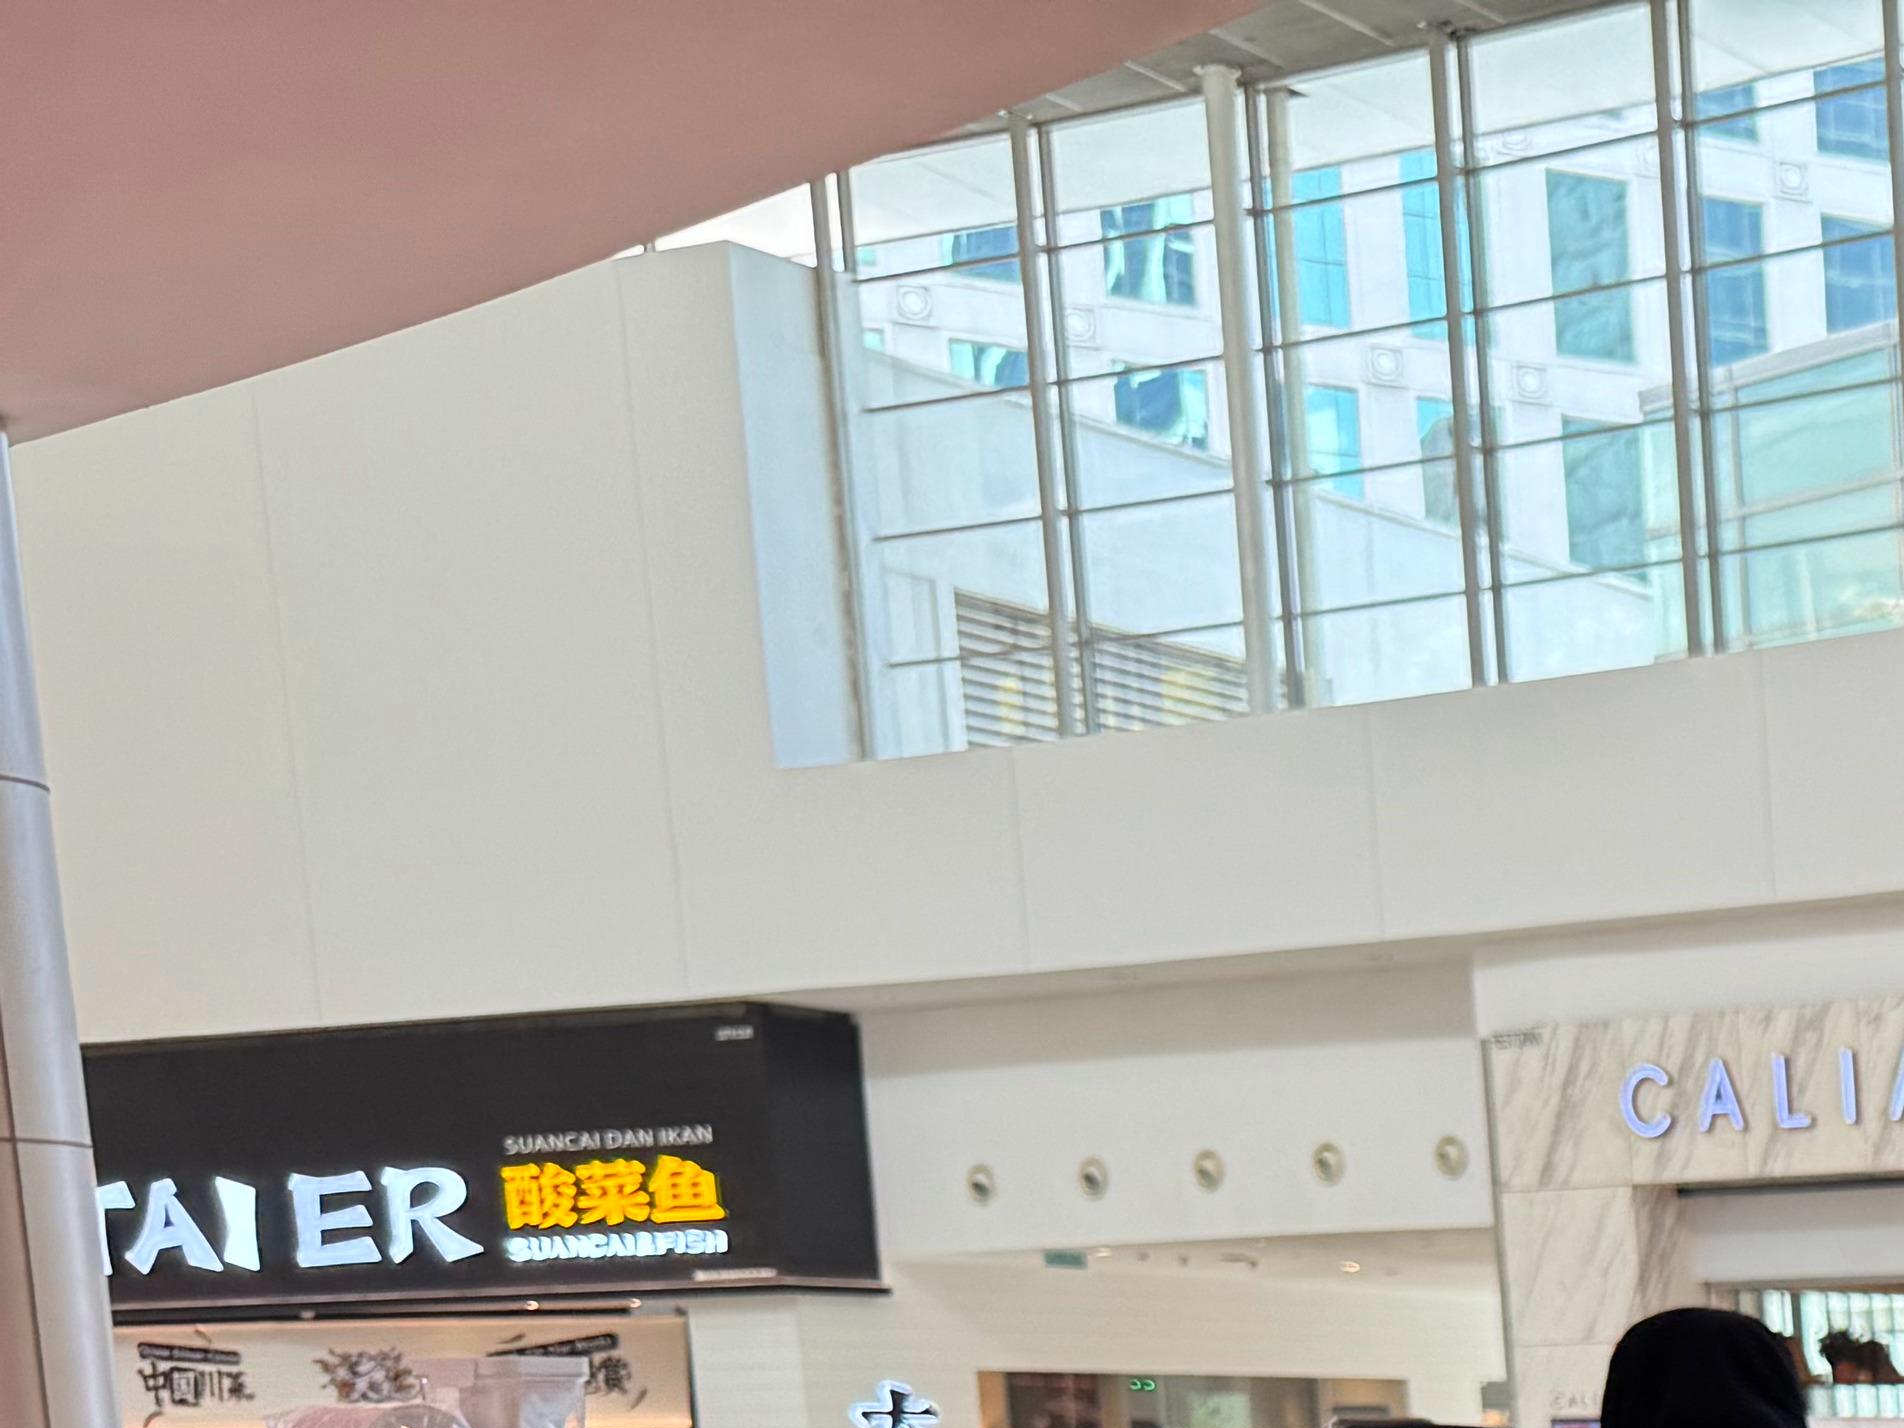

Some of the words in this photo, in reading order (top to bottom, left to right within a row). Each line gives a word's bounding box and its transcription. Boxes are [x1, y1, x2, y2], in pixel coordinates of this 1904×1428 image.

[504, 1130, 600, 1155] SUANCAI
[602, 1127, 653, 1149] DAN
[660, 1124, 713, 1145] IKAN
[287, 1166, 483, 1268] ER
[501, 1154, 726, 1230] 酸菜鱼
